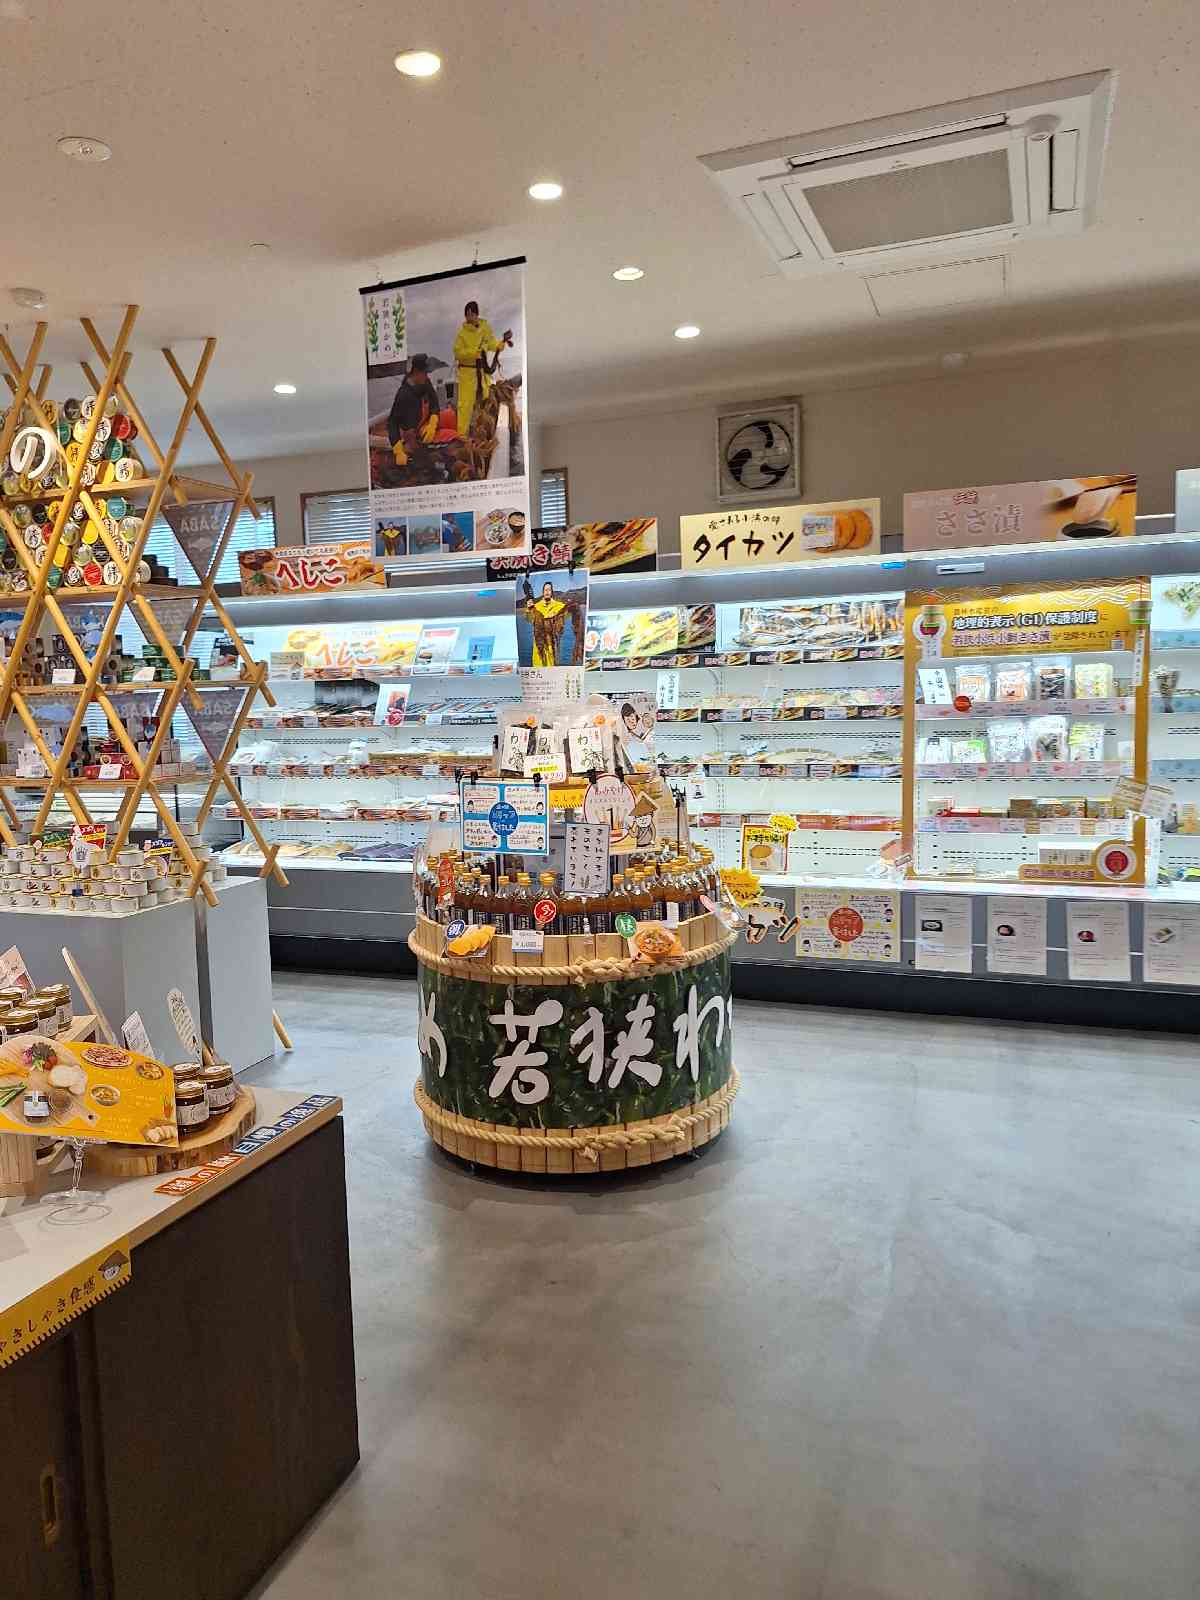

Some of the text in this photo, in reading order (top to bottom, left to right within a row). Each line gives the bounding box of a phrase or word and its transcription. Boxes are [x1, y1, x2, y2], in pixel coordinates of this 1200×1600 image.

[10, 427, 58, 480] の
[935, 503, 1024, 536] ささ漬
[693, 531, 795, 563] タイカツ
[275, 558, 344, 588] へしこ
